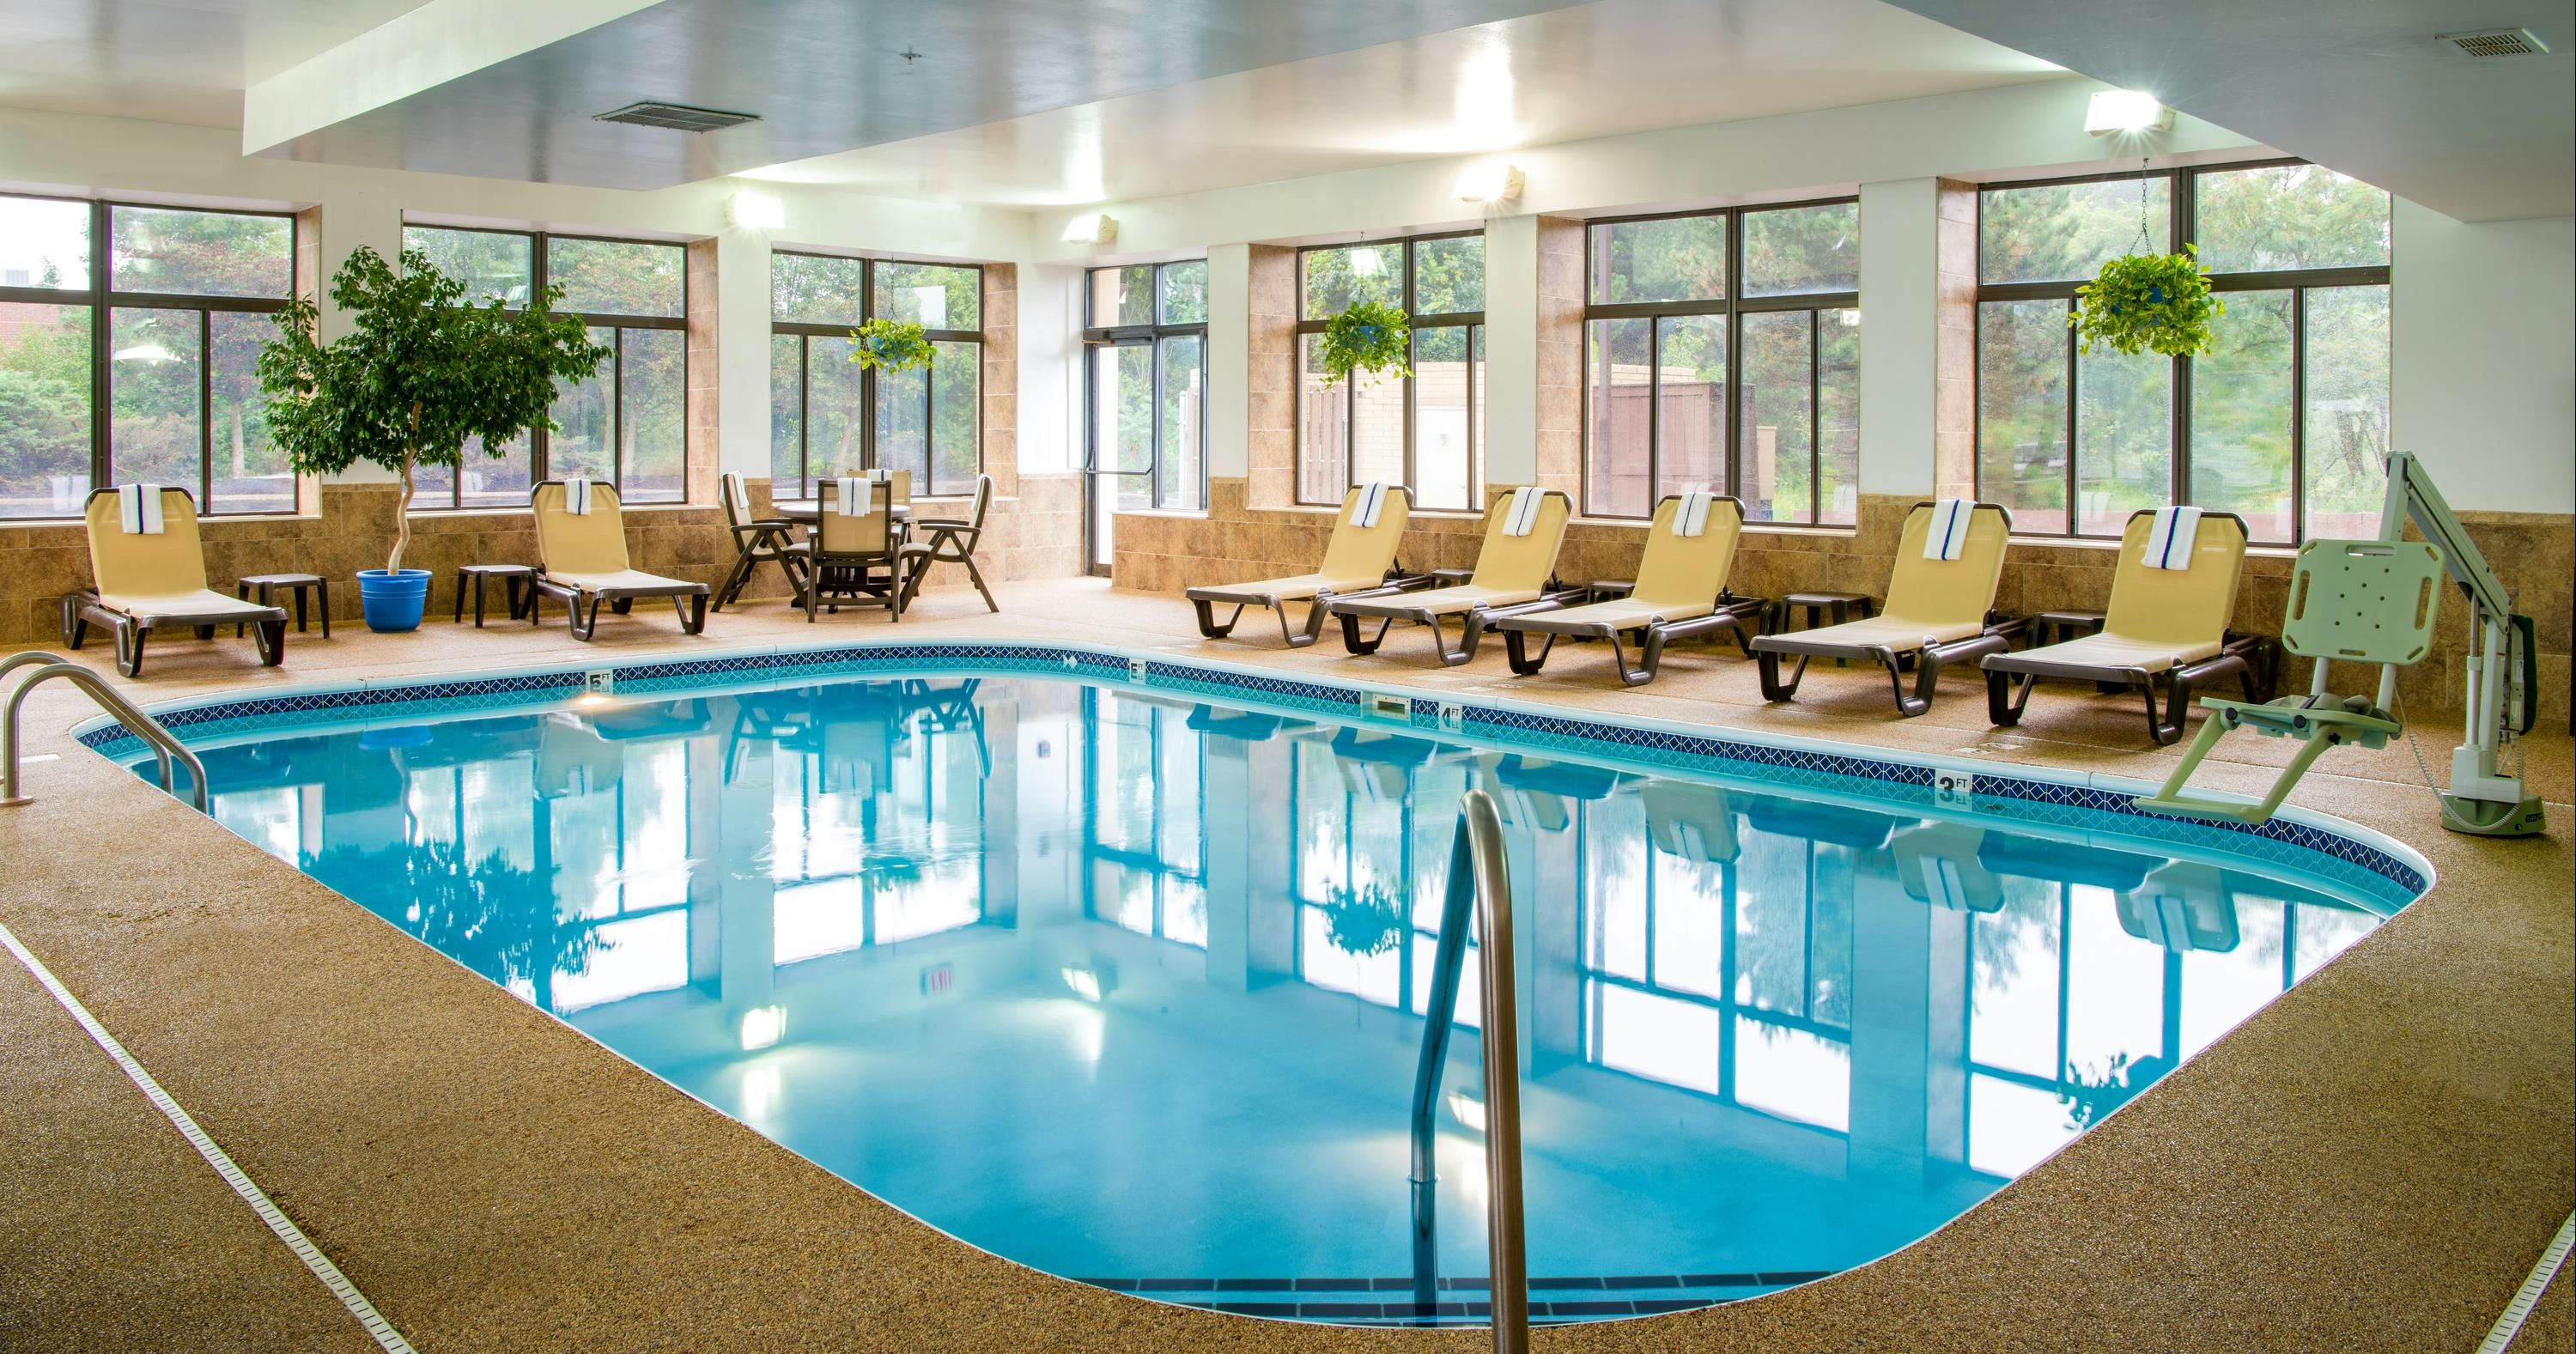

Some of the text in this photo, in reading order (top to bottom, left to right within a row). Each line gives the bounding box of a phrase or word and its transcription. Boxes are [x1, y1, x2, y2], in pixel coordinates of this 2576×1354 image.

[590, 674, 601, 684] 5
[1452, 707, 1459, 716] FT
[1940, 777, 1967, 790] 3 FT
